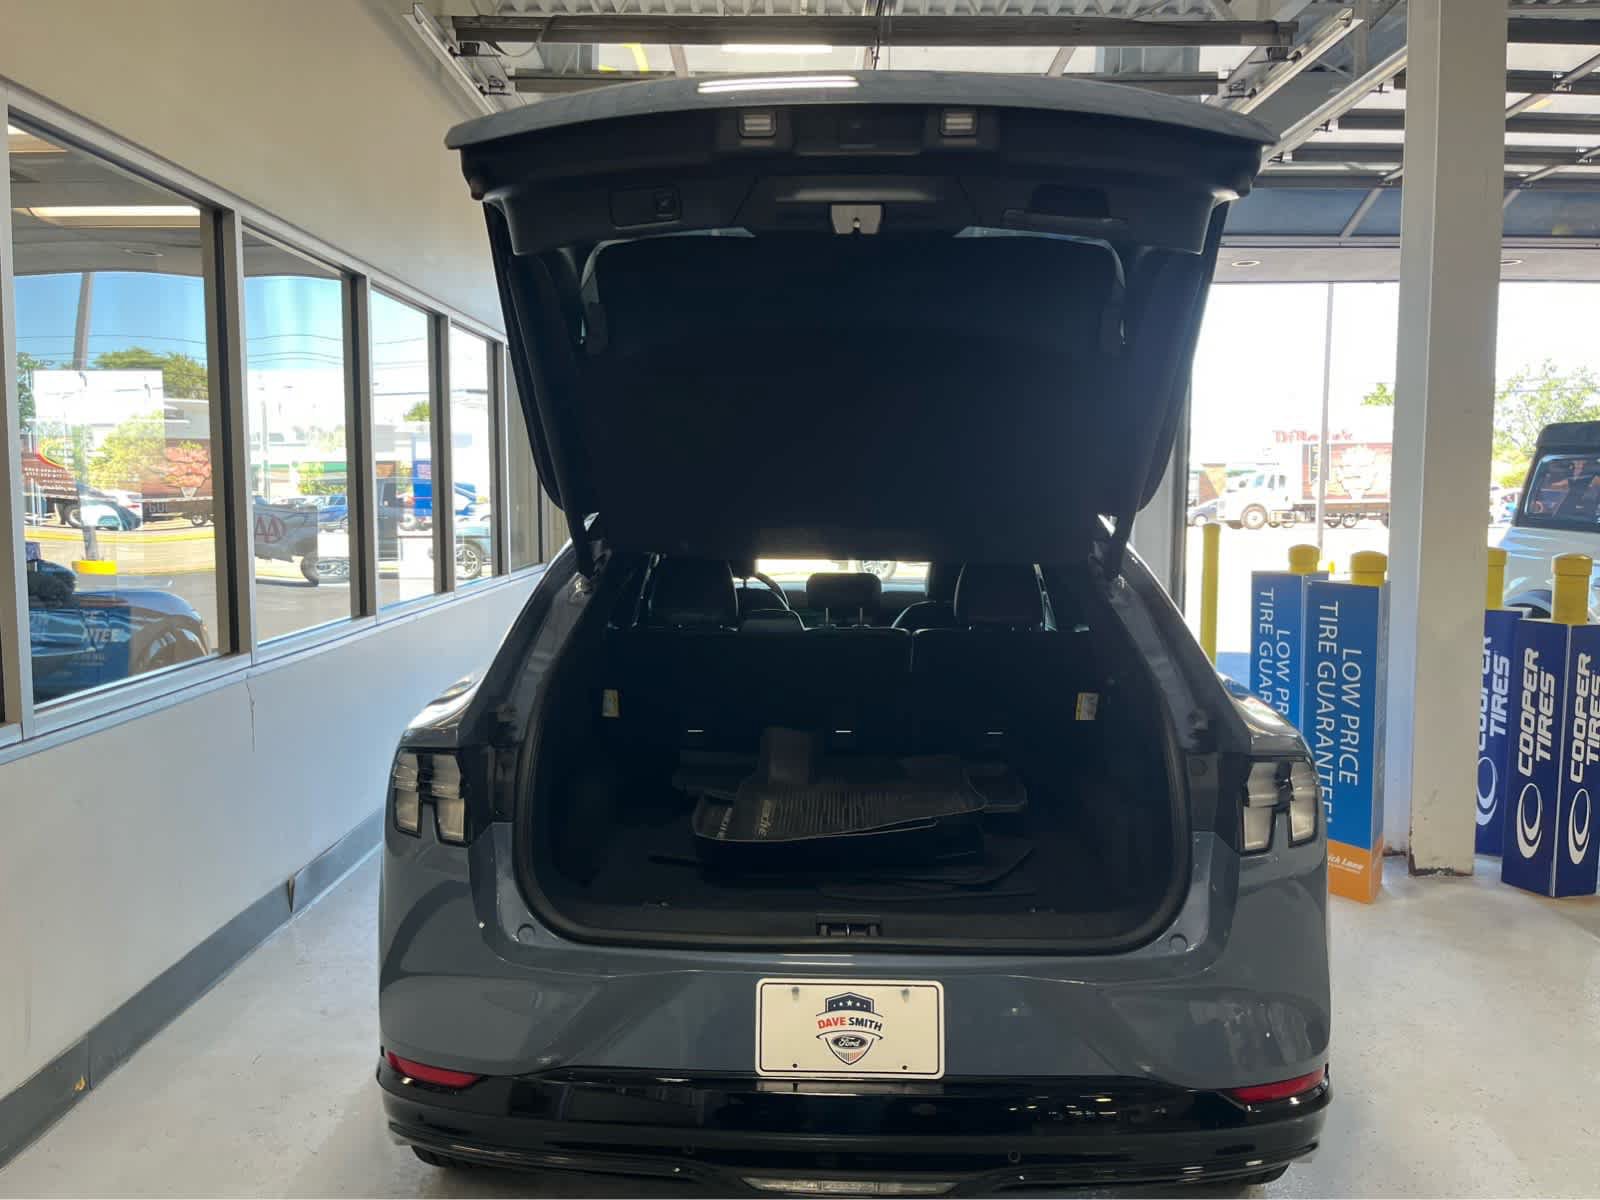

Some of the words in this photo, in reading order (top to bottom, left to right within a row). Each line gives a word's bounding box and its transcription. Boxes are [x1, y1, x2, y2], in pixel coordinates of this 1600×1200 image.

[1259, 587, 1274, 635] TIRE
[1318, 600, 1339, 655] TIRE
[1276, 629, 1291, 682] LOW
[1341, 647, 1363, 708] LOW
[1489, 653, 1510, 737] TIRES
[1517, 647, 1540, 777] COOPER
[1535, 670, 1556, 762] TIRES
[1569, 652, 1592, 783] COOPER
[1338, 713, 1361, 786] PRICE
[818, 1017, 847, 1029] DAVE
[848, 1017, 883, 1031] SMITH
